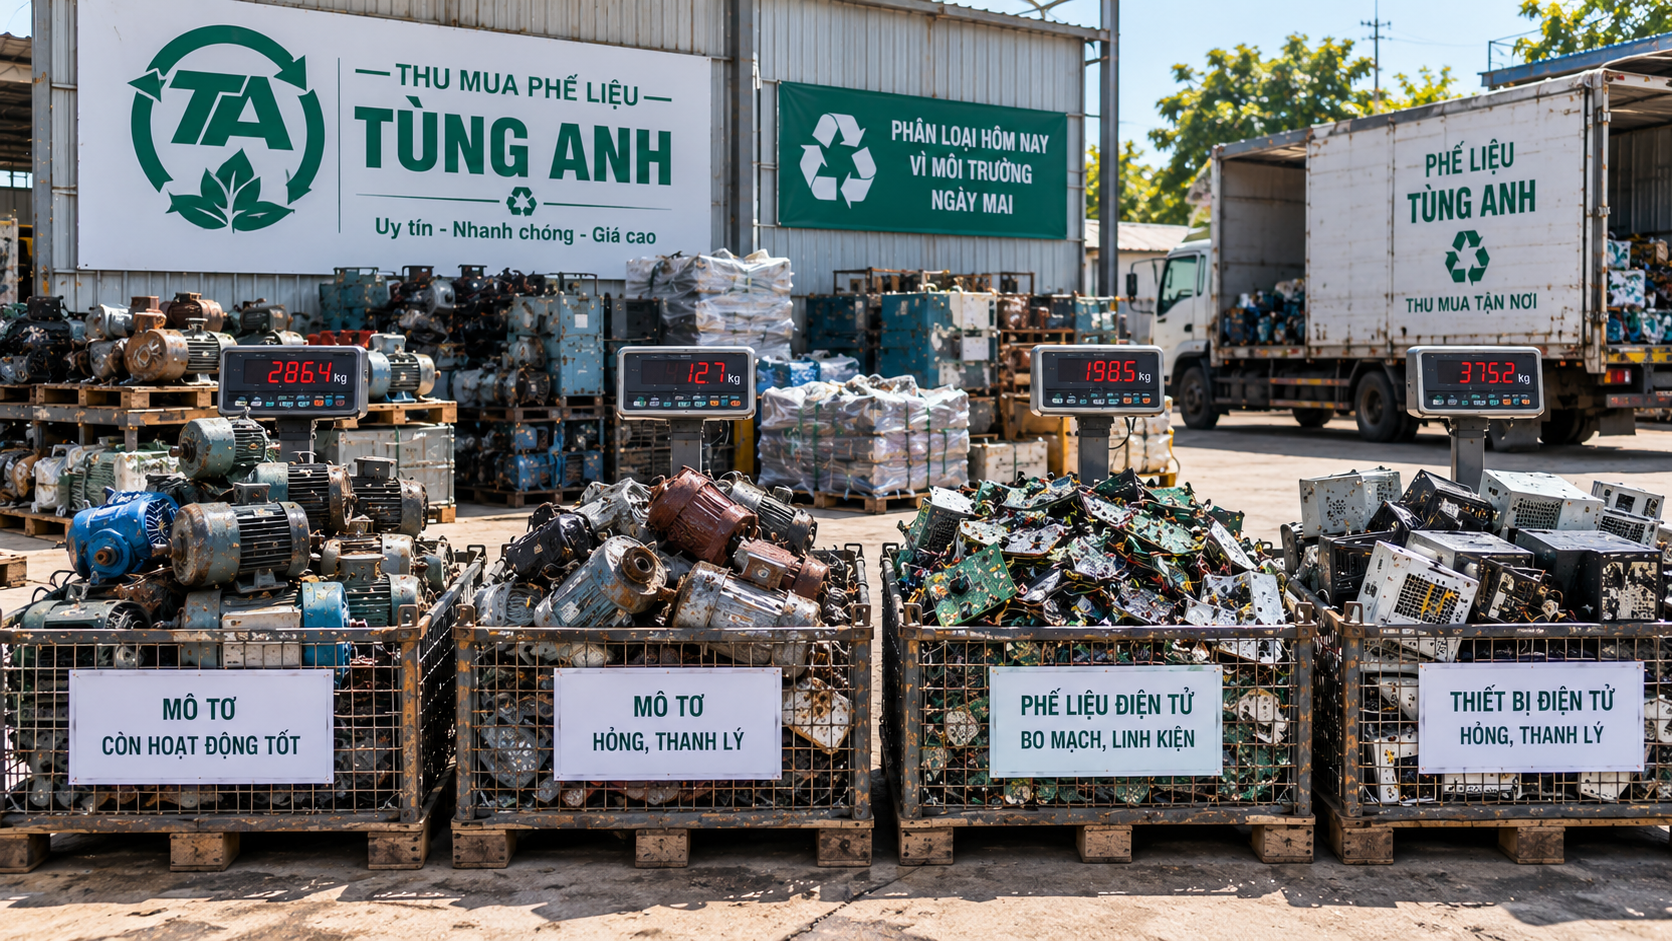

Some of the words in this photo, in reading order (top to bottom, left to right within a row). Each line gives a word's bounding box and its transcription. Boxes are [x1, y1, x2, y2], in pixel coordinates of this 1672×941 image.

[396, 63, 449, 89] THU
[460, 70, 519, 95] MUA
[529, 74, 577, 101] PHẾ
[587, 79, 638, 109] LIỆU
[170, 69, 293, 150] TA
[355, 95, 529, 177] TÙNG
[549, 123, 671, 185] ANH
[892, 118, 936, 144] PHÂN
[942, 125, 976, 151] LOẠI
[982, 126, 1015, 151] HÔM
[1020, 133, 1048, 153] NAY
[910, 151, 925, 176] VÌ
[932, 153, 962, 179] MÔI
[968, 158, 1032, 184] TRƯỜNG
[1426, 141, 1464, 177] PHẾ
[1470, 139, 1513, 175] LIỆU
[932, 187, 977, 211] NGÀY
[983, 193, 1012, 214] MAI
[1407, 184, 1471, 223] TÙNG
[1480, 180, 1535, 217] ANH
[376, 218, 401, 239] Uy
[408, 219, 432, 236] tín
[454, 221, 512, 239] Nhanh
[519, 224, 573, 245] chóng
[593, 227, 620, 243] Giá
[626, 232, 656, 244] cao
[1406, 298, 1433, 313] THU
[1439, 296, 1470, 311] MUA
[1475, 292, 1504, 314] TẬN
[1510, 293, 1536, 309] NƠI
[268, 361, 332, 383] 286.4
[334, 372, 347, 385] kg
[688, 362, 725, 384] 12.7
[728, 373, 741, 386] kg
[1086, 361, 1135, 382] 198.5
[1139, 371, 1151, 384] kg
[1460, 362, 1515, 383] 375.2
[1519, 373, 1531, 385] kg
[163, 693, 197, 720] MÔ
[206, 697, 236, 720] TƠ
[634, 691, 667, 717] MÔ
[676, 694, 704, 717] TƠ
[1022, 688, 1060, 715] PHẾ
[1067, 690, 1107, 720] LIỆU
[1115, 689, 1160, 719] ĐIỆN
[1168, 687, 1194, 714] TỬ
[1450, 685, 1505, 711] THIẾT
[1513, 691, 1530, 716] BỊ
[1537, 686, 1581, 715] ĐIỆN
[1589, 684, 1615, 711] TỬ
[103, 732, 140, 755] CÒN
[149, 736, 198, 759] HOẠT
[205, 732, 257, 759] ĐỘNG
[265, 730, 300, 755] TỐT
[594, 727, 648, 754] HỎNG,
[656, 732, 716, 750] THANH
[724, 727, 744, 750] LÝ
[1022, 731, 1044, 749] BO
[1052, 731, 1105, 753] MẠCH,
[1113, 730, 1150, 748] LINH
[1158, 726, 1194, 751] KIỆN
[1461, 721, 1513, 747] HỎNG,
[1519, 726, 1578, 745] THANH
[1584, 721, 1603, 743] LÝ
